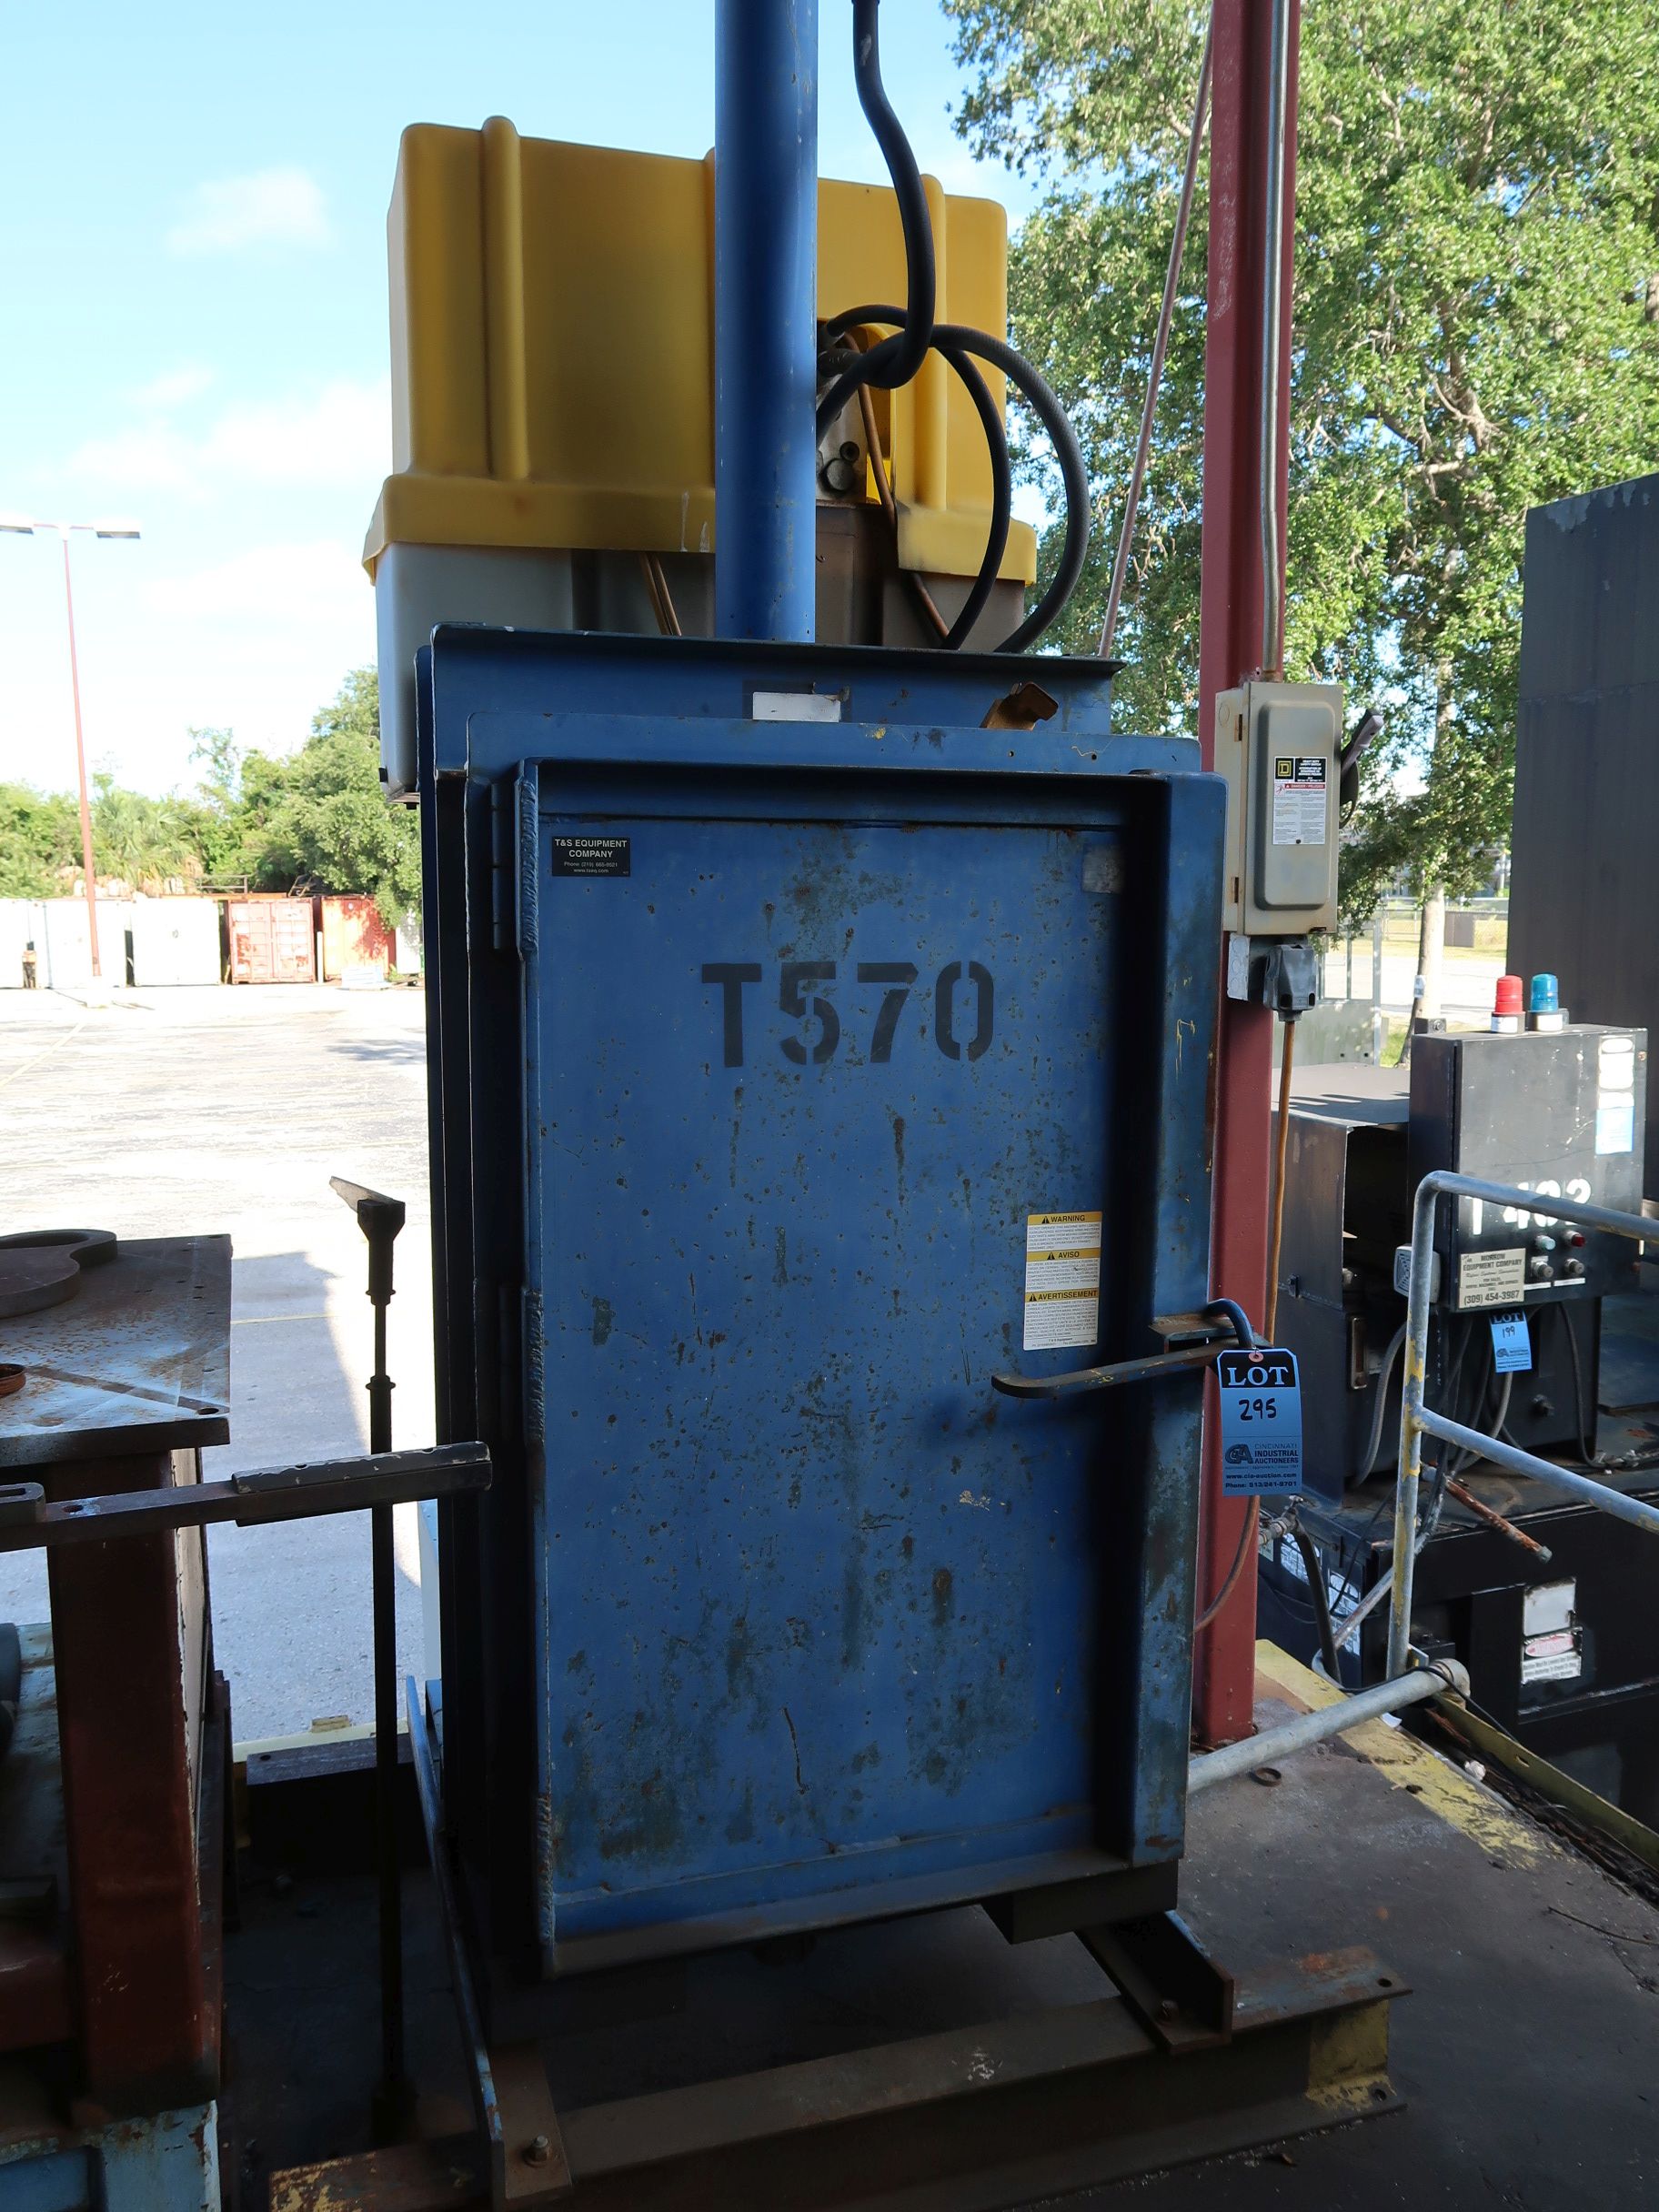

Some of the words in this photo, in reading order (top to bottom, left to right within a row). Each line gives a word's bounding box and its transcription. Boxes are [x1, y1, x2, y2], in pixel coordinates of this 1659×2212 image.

[555, 839, 573, 847] T&S
[575, 840, 628, 848] EQUIPMENT
[568, 850, 613, 858] COMPANY
[701, 960, 994, 1068] T570
[1051, 1214, 1085, 1223] WARNING
[1058, 1251, 1080, 1259] AVISO
[1463, 1262, 1494, 1272] EQUIPMENT
[1495, 1259, 1523, 1268] COMPANY
[1038, 1290, 1098, 1301] AVERTISSEMENT
[1464, 1294, 1483, 1305] (309)
[1493, 1312, 1521, 1323] LOT
[1503, 1325, 1515, 1339] 199
[1227, 1366, 1289, 1386] LOT
[1238, 1397, 1277, 1422] 295
